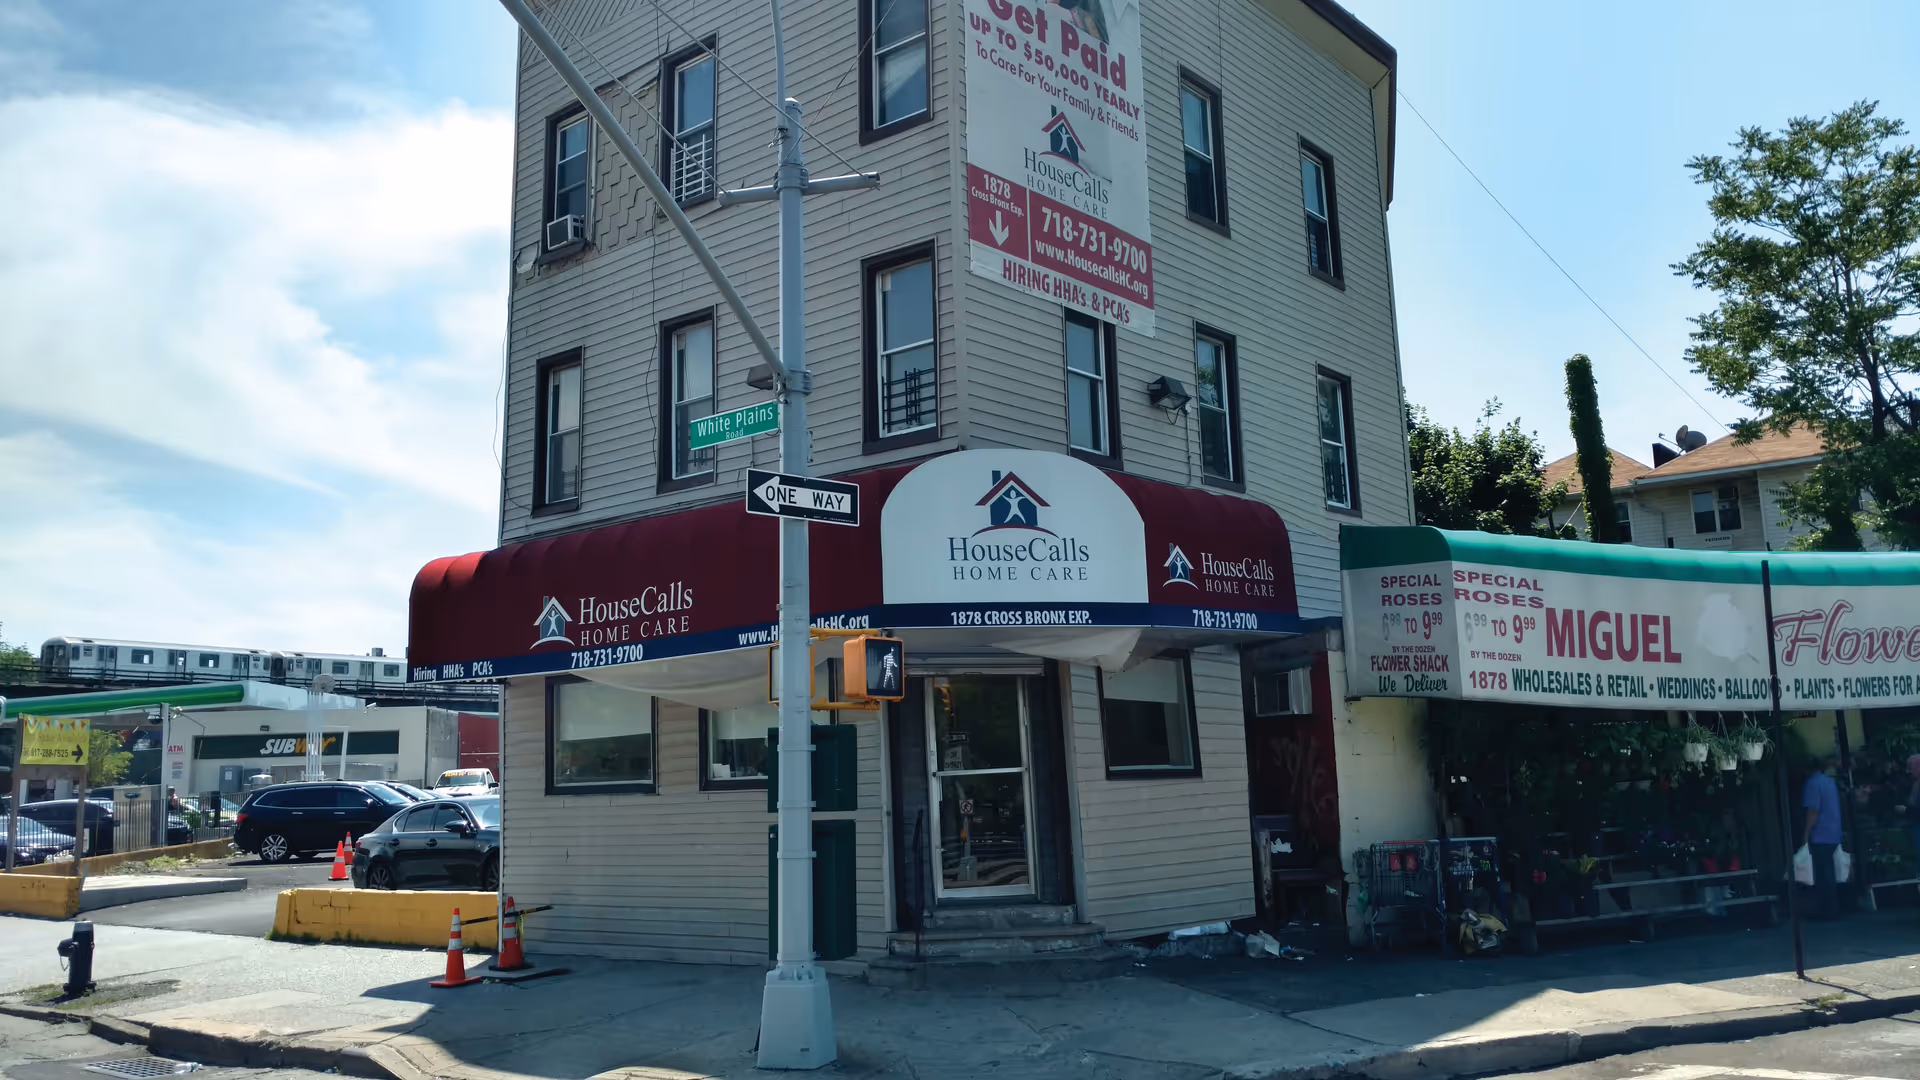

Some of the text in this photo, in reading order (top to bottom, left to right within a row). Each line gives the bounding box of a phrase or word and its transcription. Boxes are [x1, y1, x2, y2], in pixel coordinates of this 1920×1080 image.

[987, 0, 1127, 91] Get Paid
[969, 12, 1140, 121] UP TO $50,000 YEARLY
[975, 39, 1139, 142] To Care For Your Family & Friends
[983, 174, 1011, 199] 1878
[1023, 147, 1109, 204] HouseCalls
[971, 186, 1024, 217] Cross Bronx Exp.
[1027, 174, 1108, 220] HOME CARE
[1041, 206, 1147, 274] 718-731-9700
[1035, 239, 1149, 300] www.HousecallsHC.org
[1002, 258, 1130, 324] HIRING HHA's & PCA's
[697, 406, 773, 437] White Plains
[725, 428, 744, 440] Road
[765, 485, 845, 510] ONE WAY
[947, 537, 1090, 562] HouseCalls
[952, 566, 1088, 581] HOME CARE
[1200, 552, 1274, 581] HouseCalls
[1205, 578, 1275, 597] HOME CARE
[1380, 574, 1442, 588] SPECIAL
[1453, 570, 1544, 592] SPECIAL
[578, 581, 693, 625] HouseCalls
[1381, 592, 1443, 607] ROSES
[1453, 588, 1545, 609] ROSES
[950, 610, 1092, 625] 1878 CROSS BRONX EXP.
[1192, 609, 1258, 629] 718-731-9700
[1404, 617, 1418, 634] TO
[1491, 619, 1507, 636] TO
[580, 615, 690, 646] HOME CARE
[1545, 607, 1682, 664] MIGUEL
[570, 643, 643, 669] 718-731-9700
[1391, 644, 1436, 653] BY THE DOZEN
[1470, 650, 1522, 662] BY THE DOZEN
[413, 660, 493, 682] Hiring HHA's PCA's
[1371, 654, 1449, 672] FLOWER SHACK
[1378, 674, 1448, 693] We Deliver
[1469, 670, 1508, 691] 1878
[1512, 668, 1592, 696] WHOLESALES
[1596, 674, 1604, 696] &
[1607, 675, 1648, 698] RETAIL
[1657, 676, 1716, 700] WEDDINGS
[1794, 678, 1835, 699] PLANTS
[1843, 677, 1891, 698] FLOWERS
[1893, 675, 1913, 697] FOR
